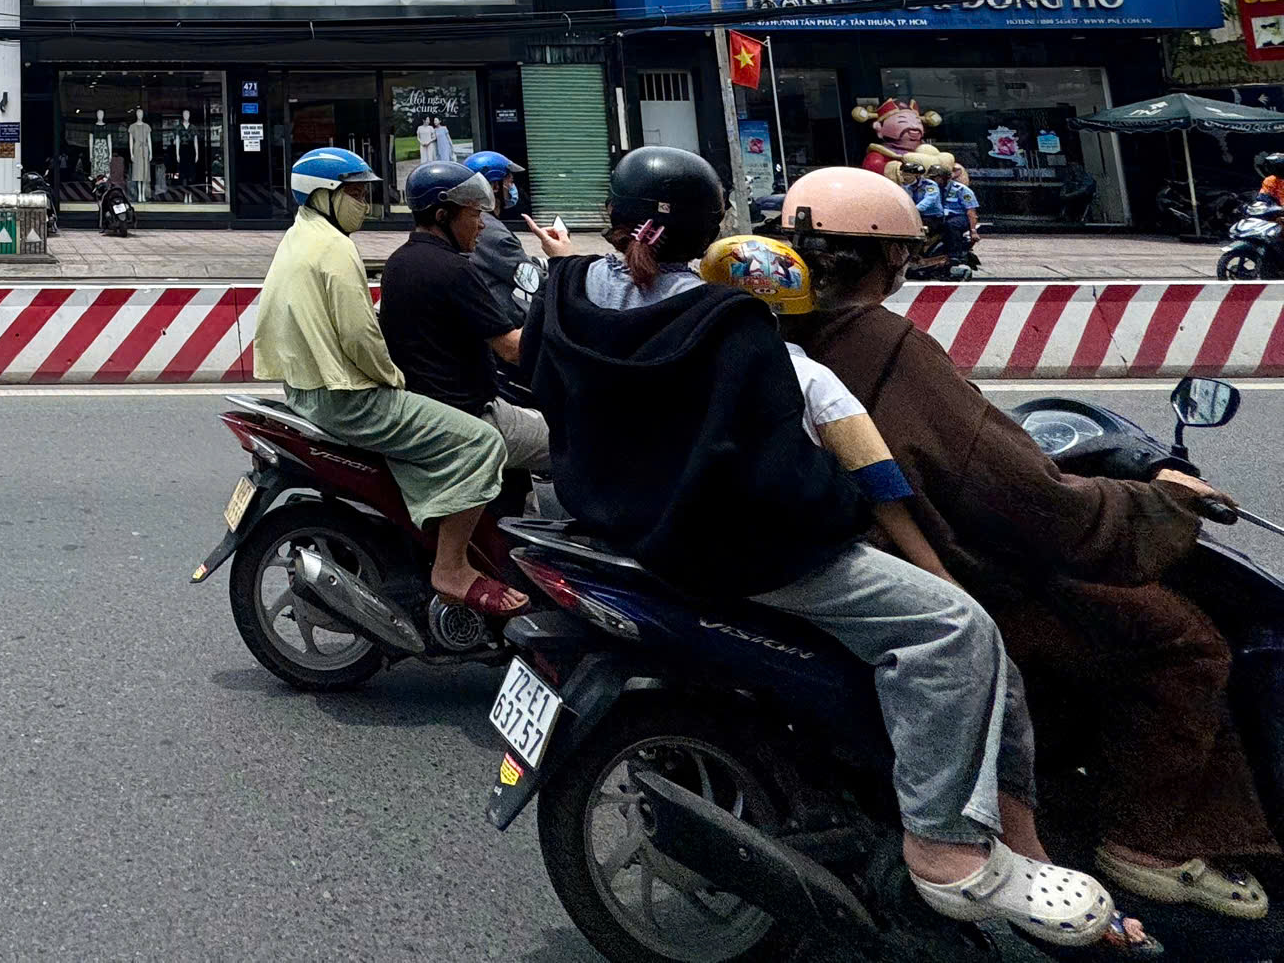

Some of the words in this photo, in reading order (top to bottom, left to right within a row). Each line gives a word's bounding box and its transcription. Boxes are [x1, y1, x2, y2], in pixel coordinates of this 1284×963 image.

[243, 82, 257, 90] 471
[509, 666, 550, 722] 72-E1
[493, 693, 544, 758] 637.57
